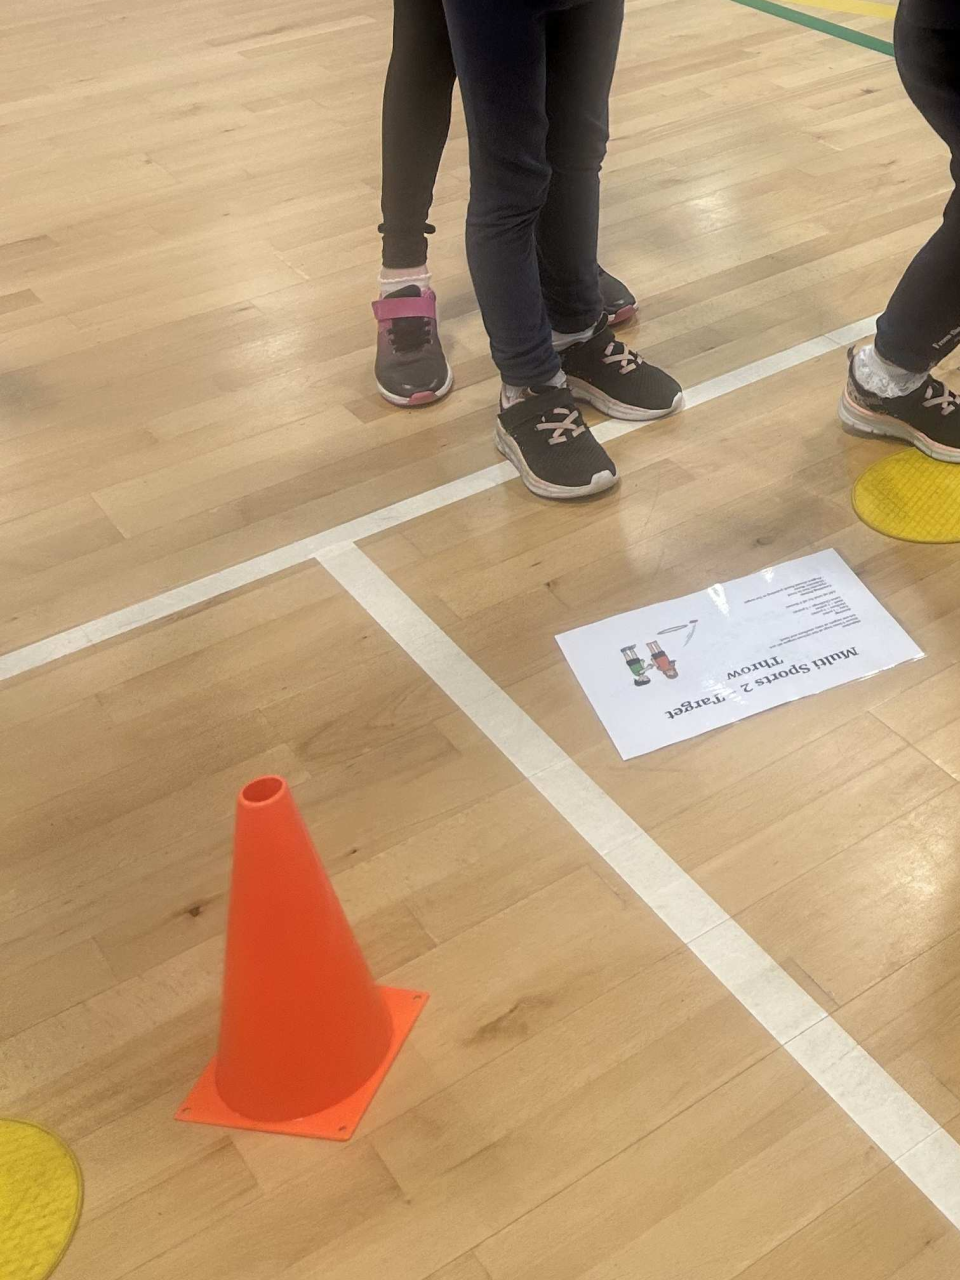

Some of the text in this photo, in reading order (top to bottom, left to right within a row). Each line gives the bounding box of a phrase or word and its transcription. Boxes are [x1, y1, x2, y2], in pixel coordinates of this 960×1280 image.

[932, 335, 951, 349] From
[726, 655, 784, 681] Throw
[811, 646, 860, 670] Multi
[754, 663, 811, 687] Sports
[740, 683, 754, 694] 2
[664, 693, 726, 720] Target
